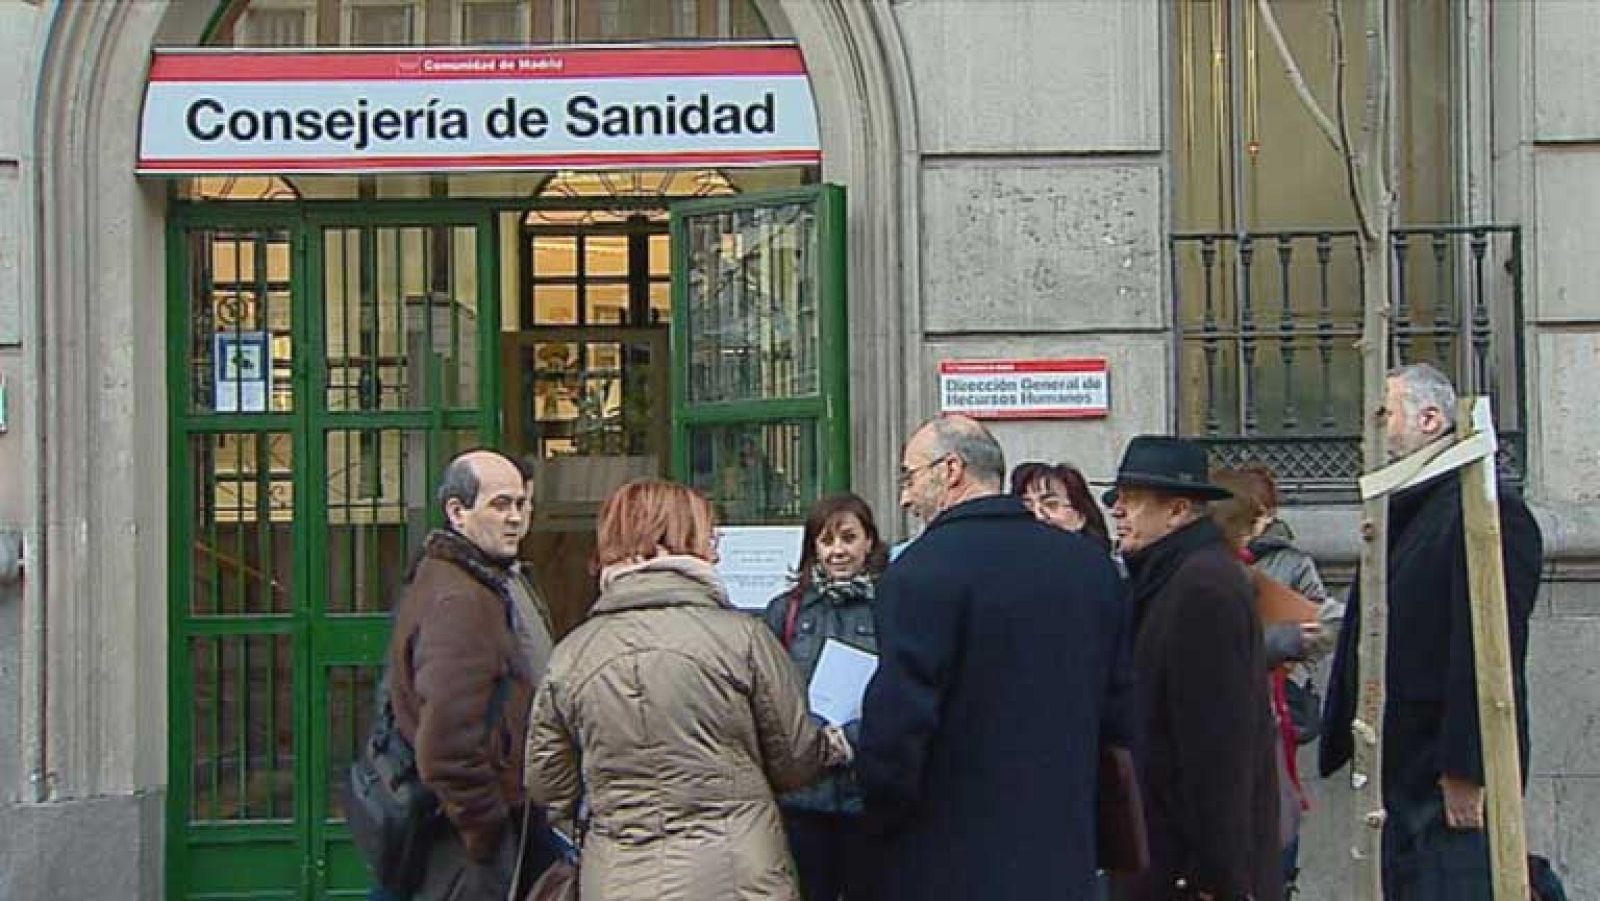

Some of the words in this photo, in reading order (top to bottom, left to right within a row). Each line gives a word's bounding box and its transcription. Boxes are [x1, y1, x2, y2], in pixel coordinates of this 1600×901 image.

[424, 58, 495, 71] Comunidad
[500, 59, 516, 70] de
[519, 58, 564, 71] Madrid
[186, 97, 467, 149] Consejería
[485, 98, 548, 138] de
[566, 92, 776, 137] Sanidad
